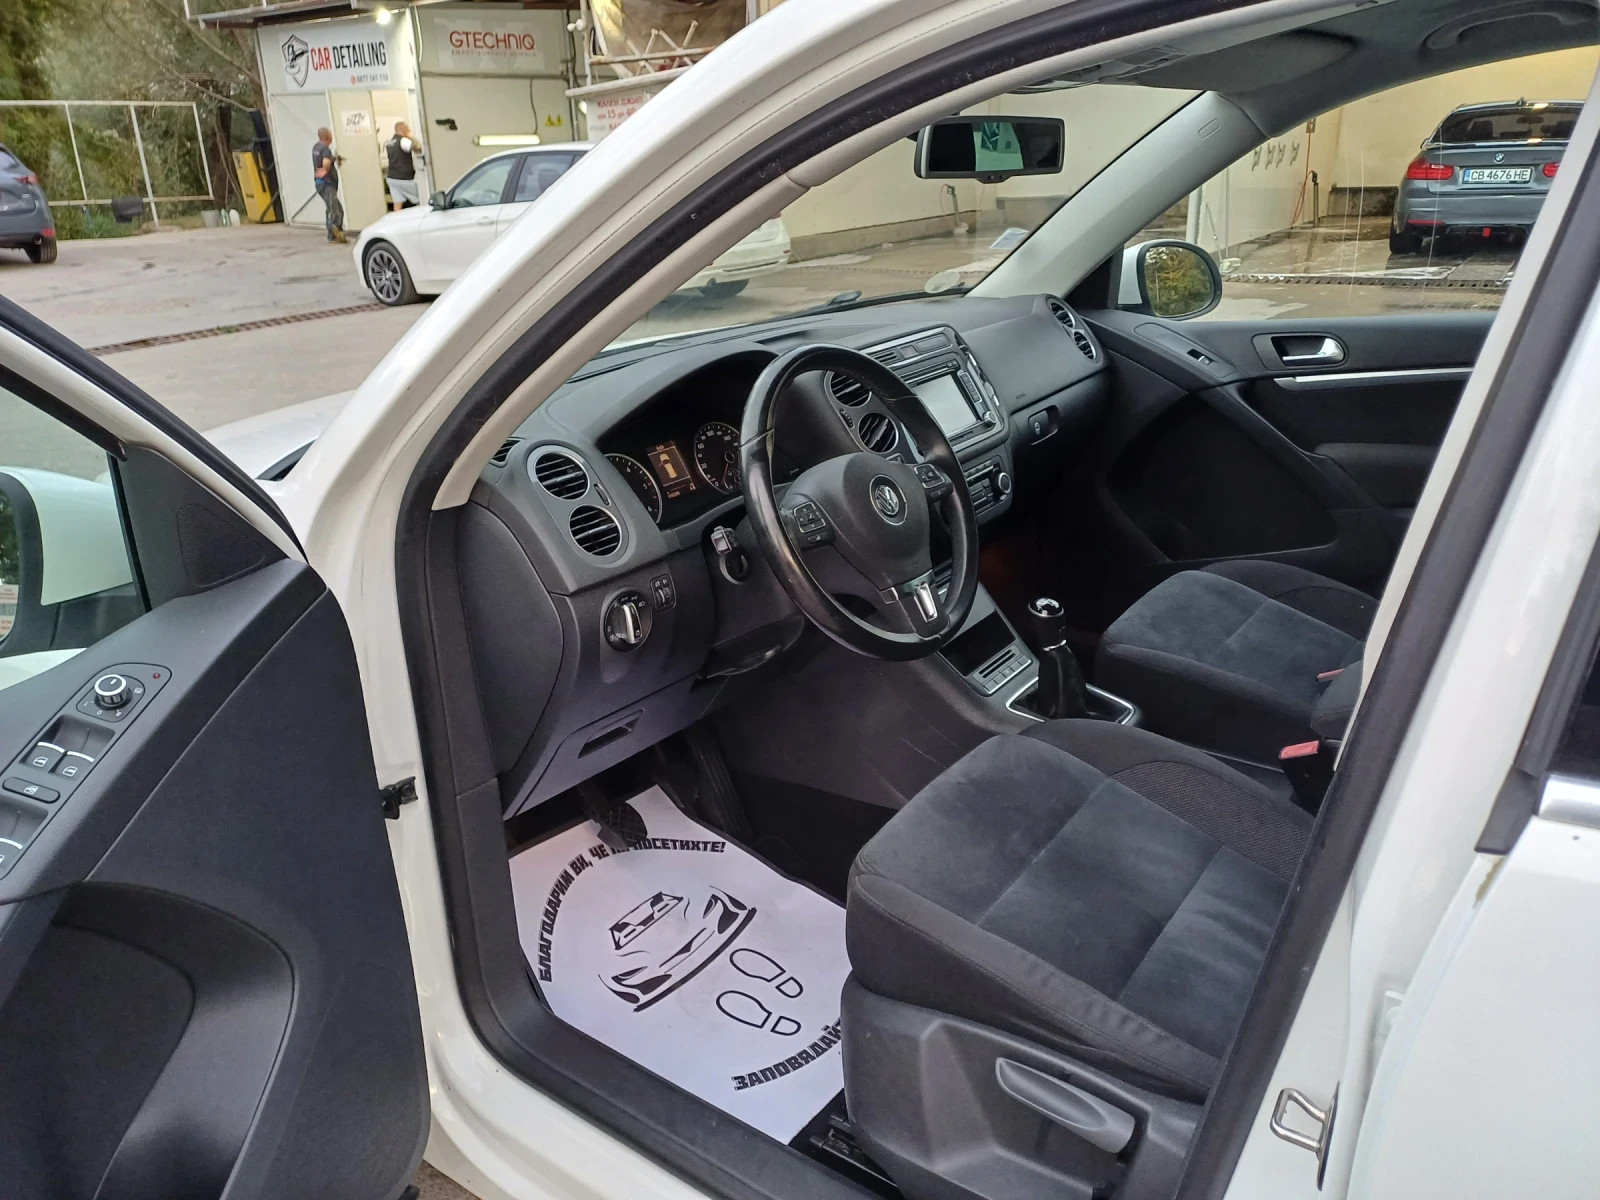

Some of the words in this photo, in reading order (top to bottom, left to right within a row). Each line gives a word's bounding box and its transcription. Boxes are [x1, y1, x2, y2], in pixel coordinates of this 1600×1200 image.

[449, 30, 536, 51] GTECHNIQ
[310, 47, 333, 71] CAR
[332, 41, 387, 69] DETAILING
[607, 109, 616, 119] 15
[1470, 170, 1485, 181] CB
[1486, 170, 1512, 180] 4676
[1513, 170, 1528, 180] HE
[538, 868, 575, 983] БЛАГОДАРИМ
[568, 853, 594, 877] ВИ,
[588, 843, 610, 860] ЧЕ
